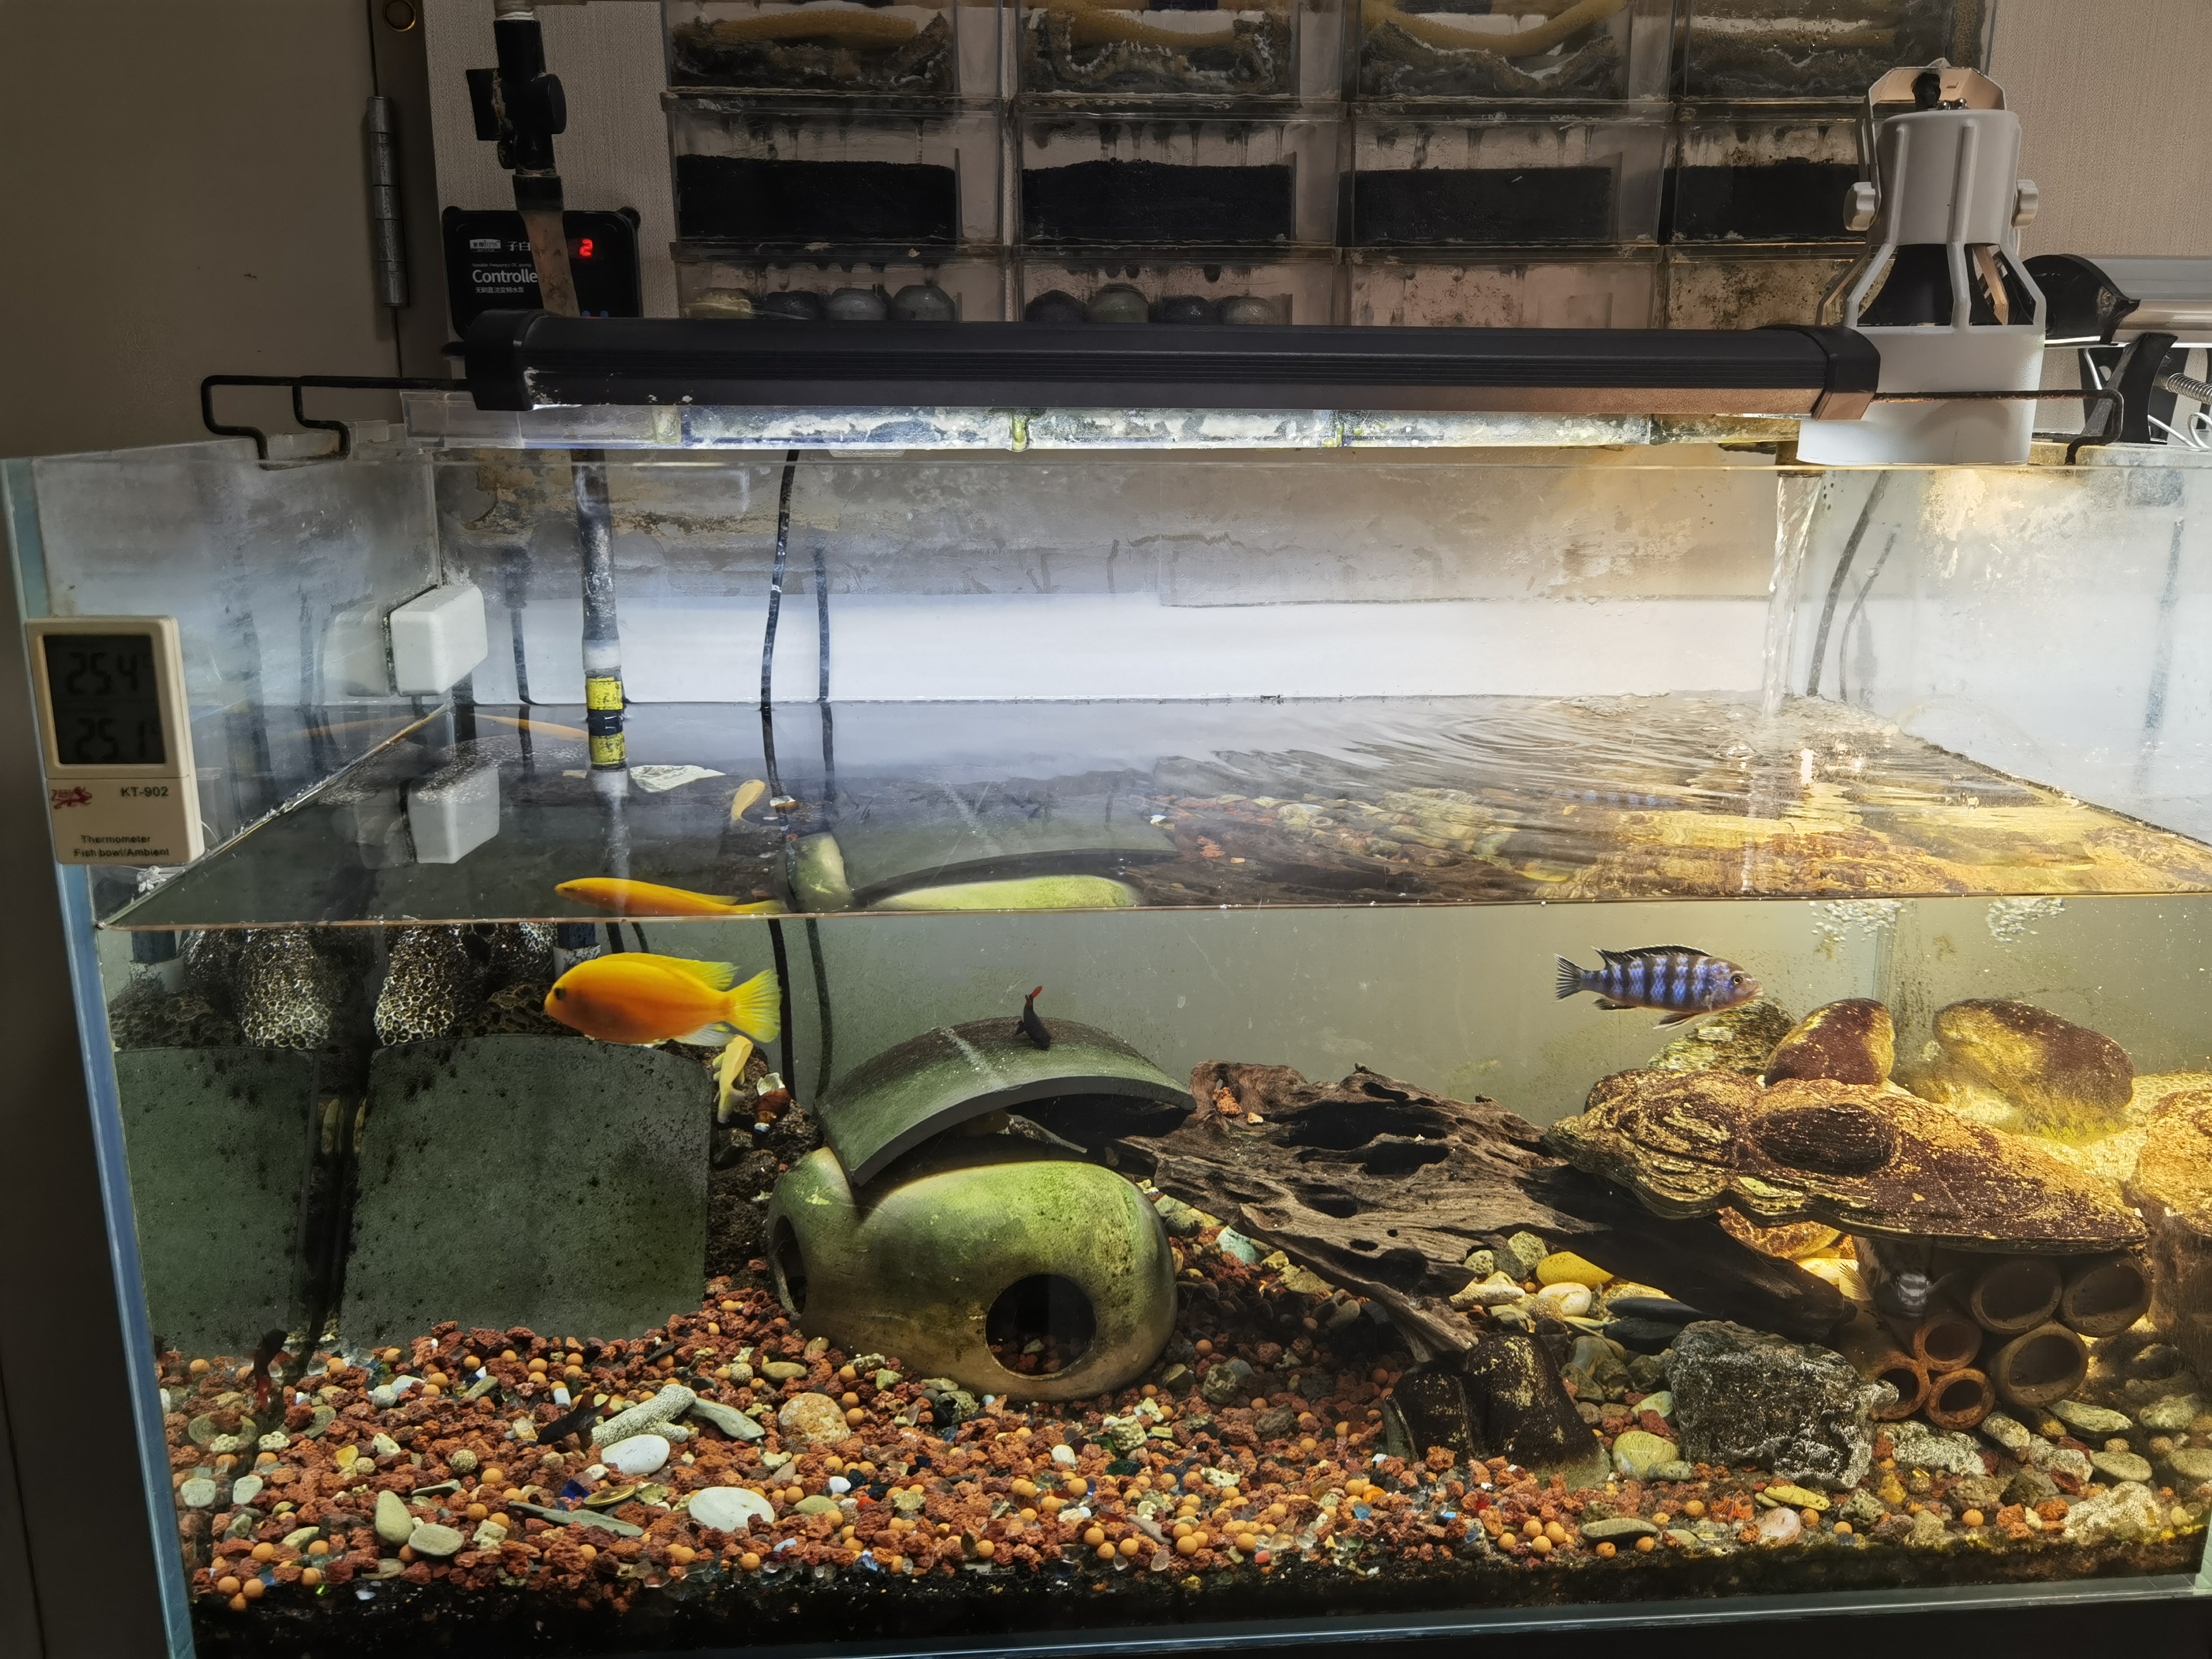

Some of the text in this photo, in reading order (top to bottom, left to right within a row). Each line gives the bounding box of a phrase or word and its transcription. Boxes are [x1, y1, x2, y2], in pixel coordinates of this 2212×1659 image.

[580, 238, 594, 257] 2
[472, 268, 538, 283] Controlle
[120, 786, 169, 797] KT-902
[81, 835, 151, 844] Thermometer
[73, 848, 97, 857] Fish
